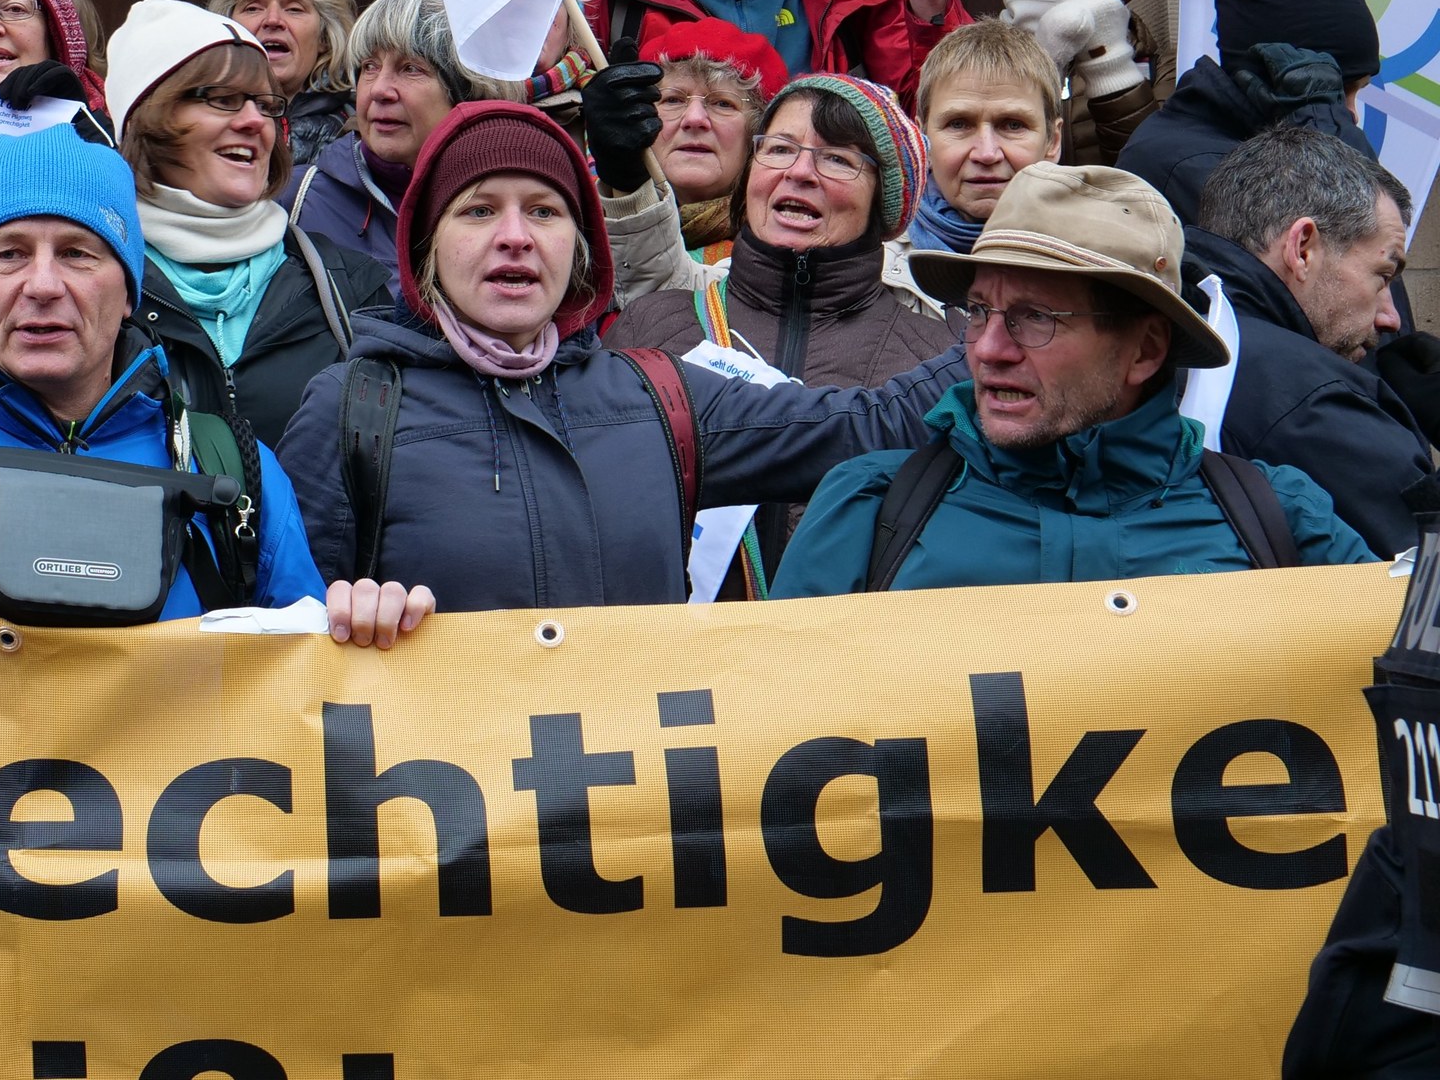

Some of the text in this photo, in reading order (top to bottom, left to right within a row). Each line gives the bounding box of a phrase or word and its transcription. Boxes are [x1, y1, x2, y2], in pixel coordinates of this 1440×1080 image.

[708, 358, 755, 382] Geht doch!
[38, 562, 82, 574] ORTLIEB
